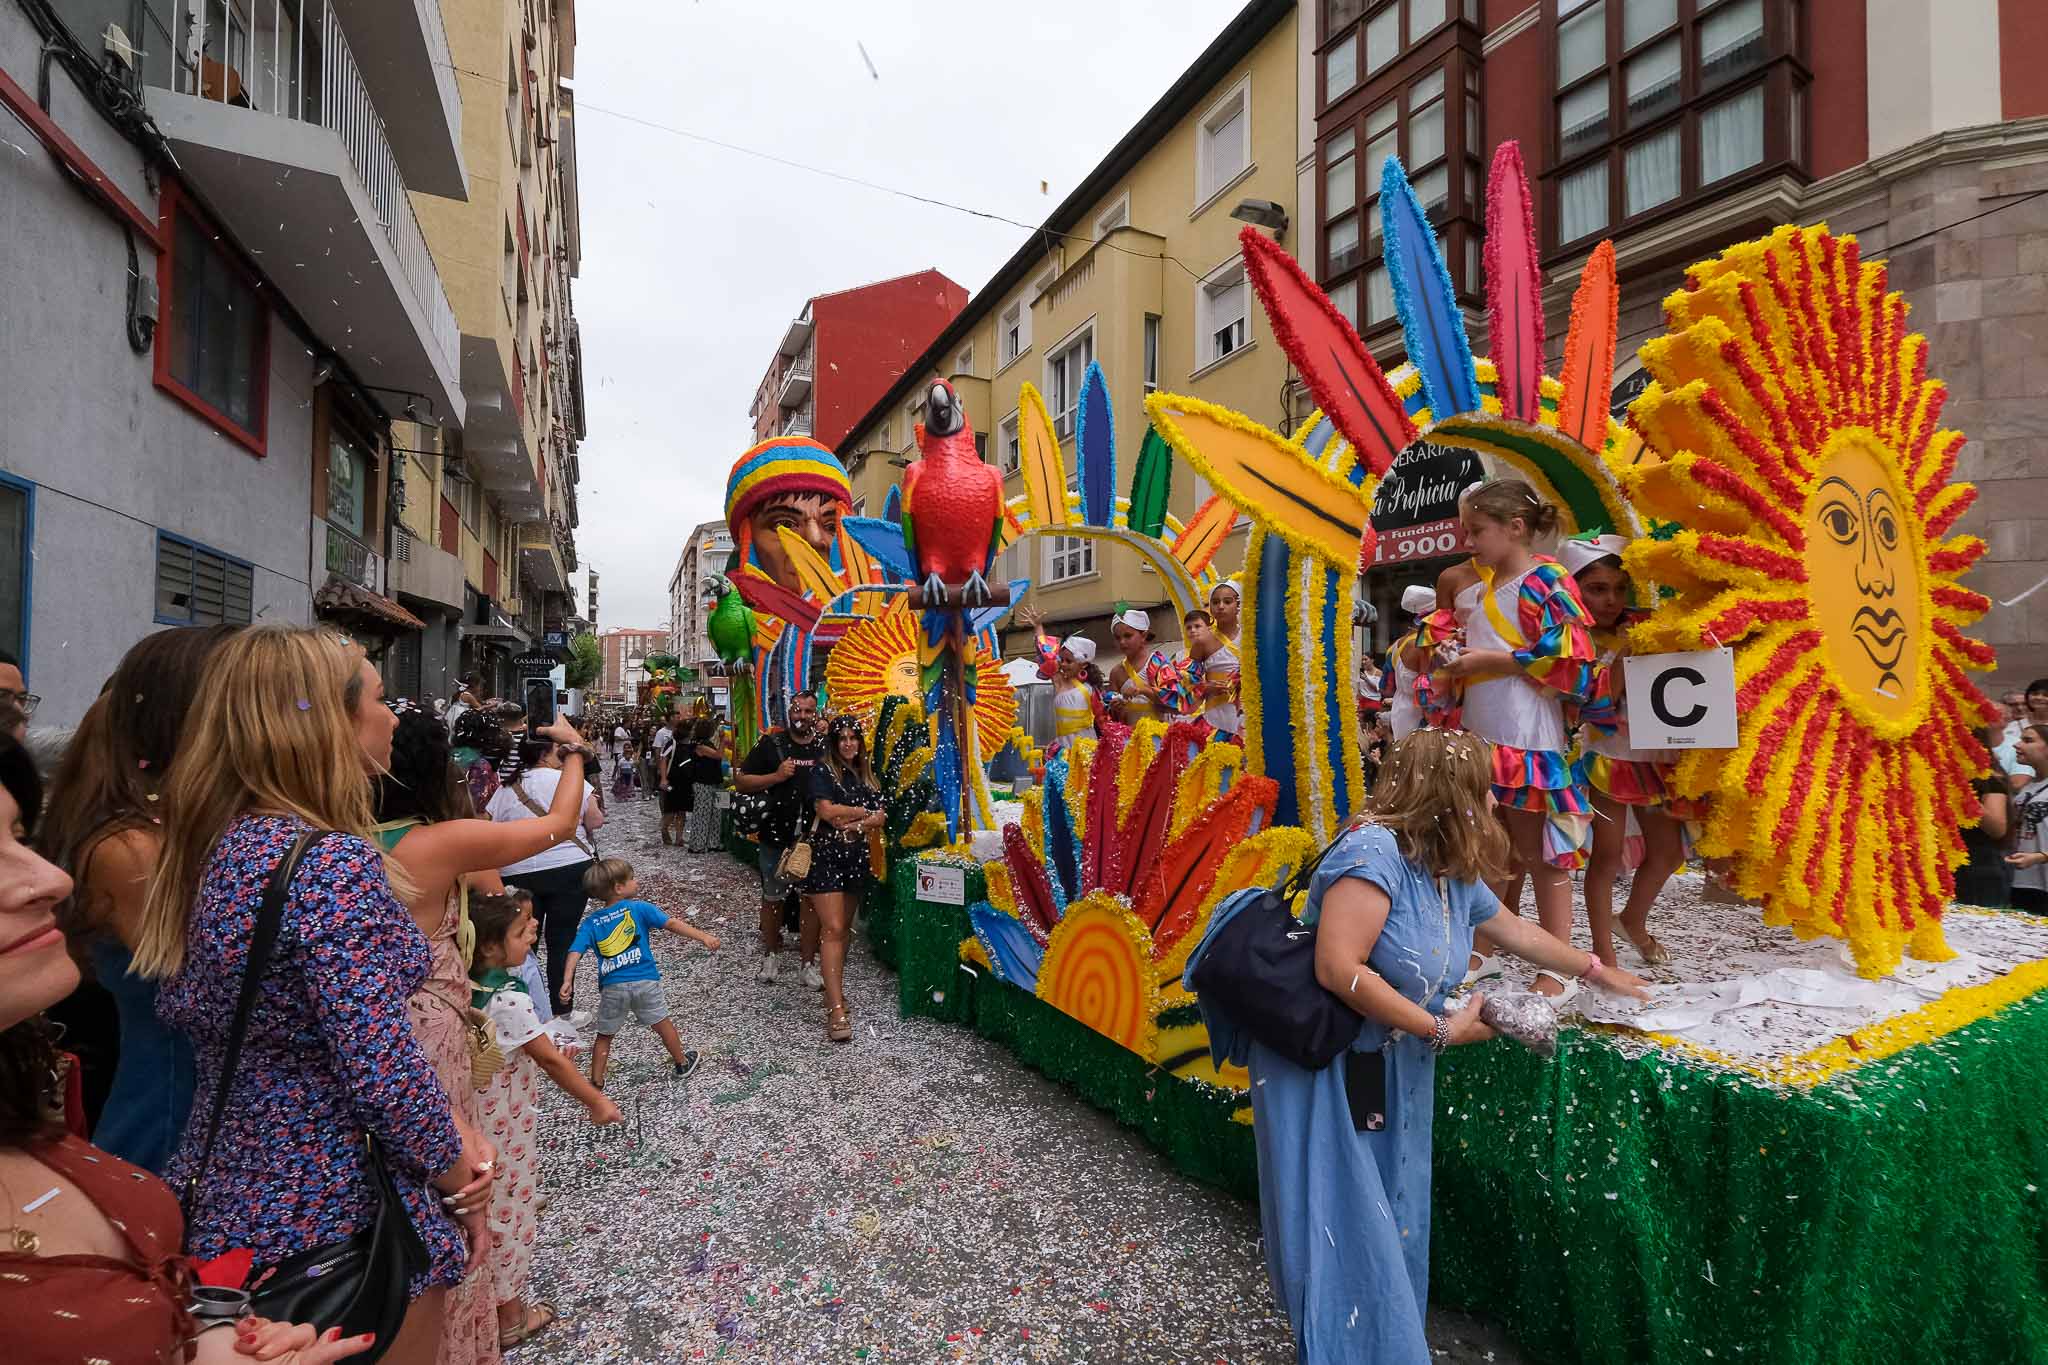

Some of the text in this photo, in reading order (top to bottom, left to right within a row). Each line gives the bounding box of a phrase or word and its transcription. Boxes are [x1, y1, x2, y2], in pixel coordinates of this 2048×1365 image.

[1391, 521, 1455, 539] Fundada
[1374, 533, 1457, 562] 1.900
[1650, 667, 1708, 728] C
